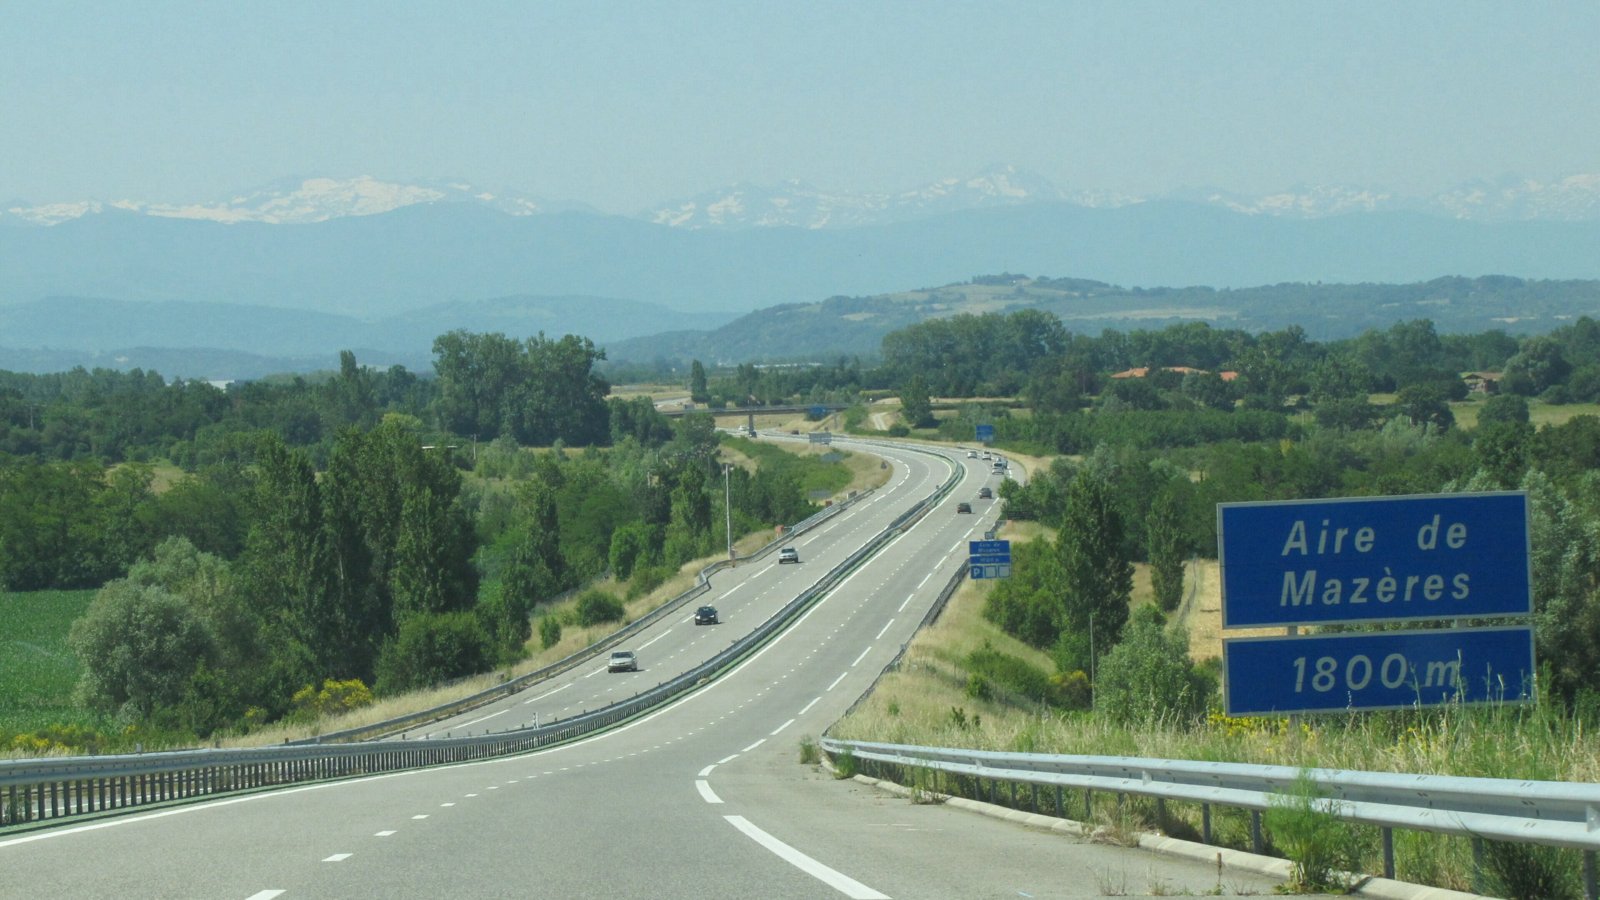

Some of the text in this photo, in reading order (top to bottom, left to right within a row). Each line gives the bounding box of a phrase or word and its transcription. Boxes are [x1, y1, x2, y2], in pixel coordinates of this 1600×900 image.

[1281, 514, 1467, 556] Aire de
[973, 567, 981, 577] P
[1280, 567, 1470, 606] Mazères
[1293, 653, 1458, 692] 1800 m
